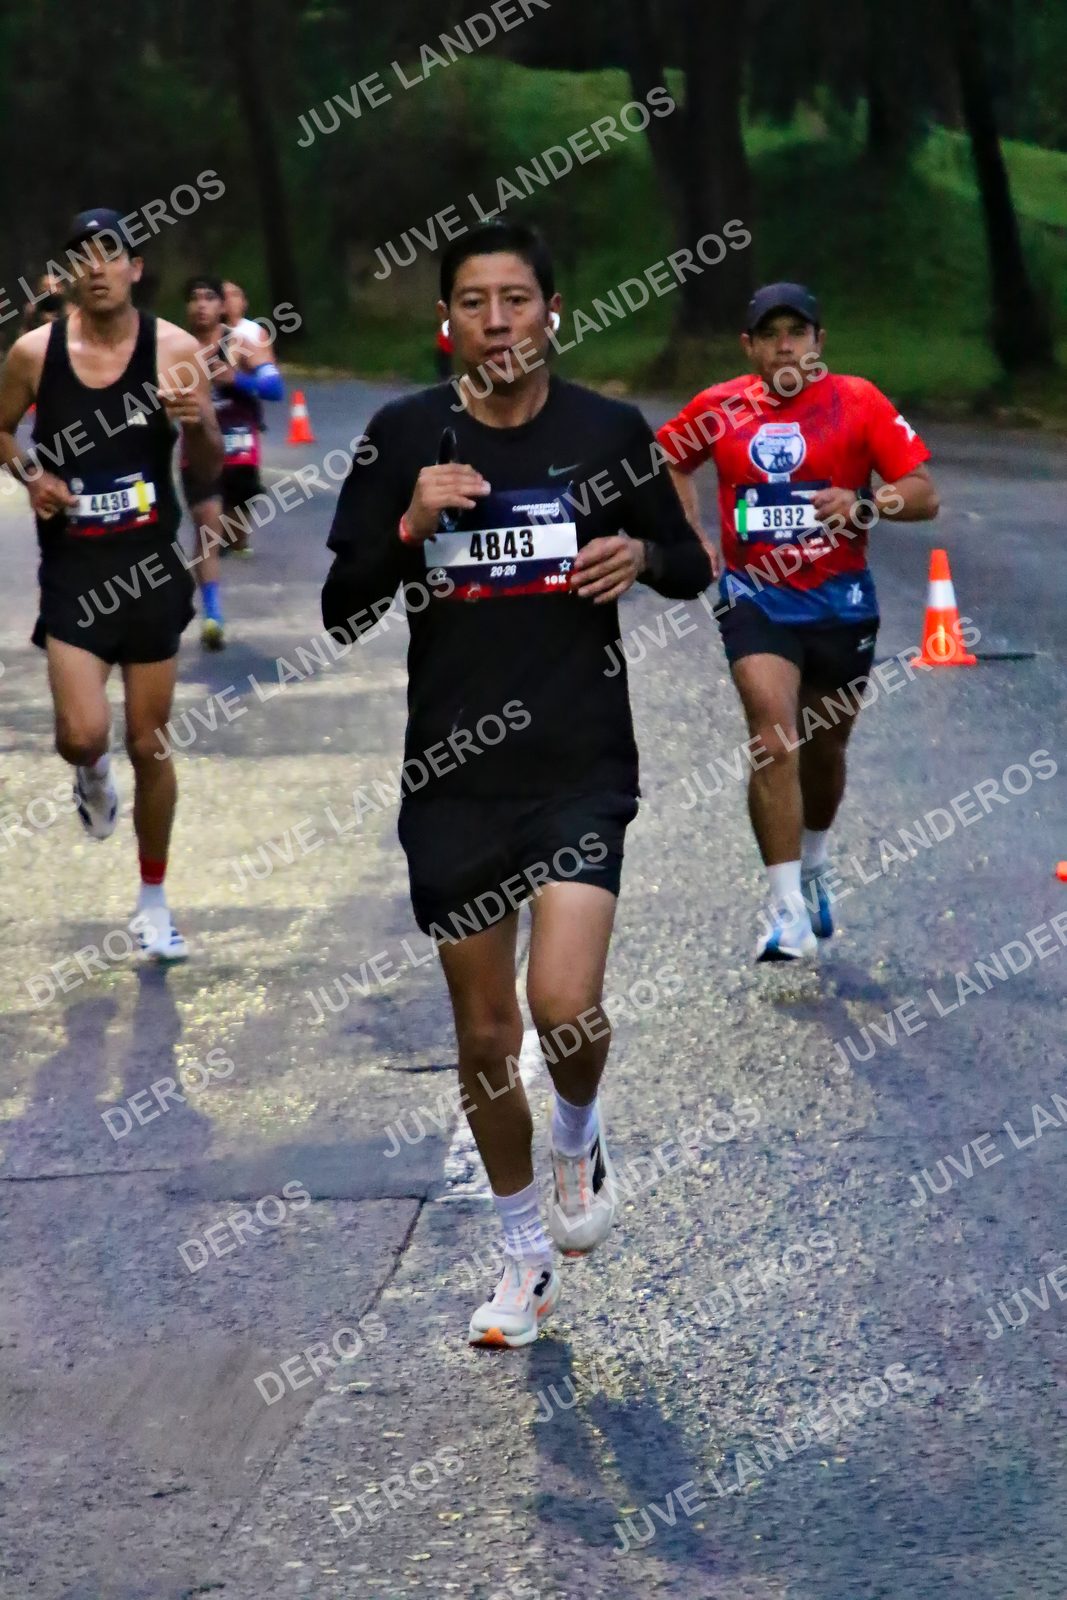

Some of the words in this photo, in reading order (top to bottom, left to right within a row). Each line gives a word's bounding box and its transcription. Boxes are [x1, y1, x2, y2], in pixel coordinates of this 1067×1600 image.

[91, 491, 130, 513] 4438
[762, 507, 805, 528] 3832
[469, 529, 535, 561] 4843
[544, 574, 567, 585] 10K
